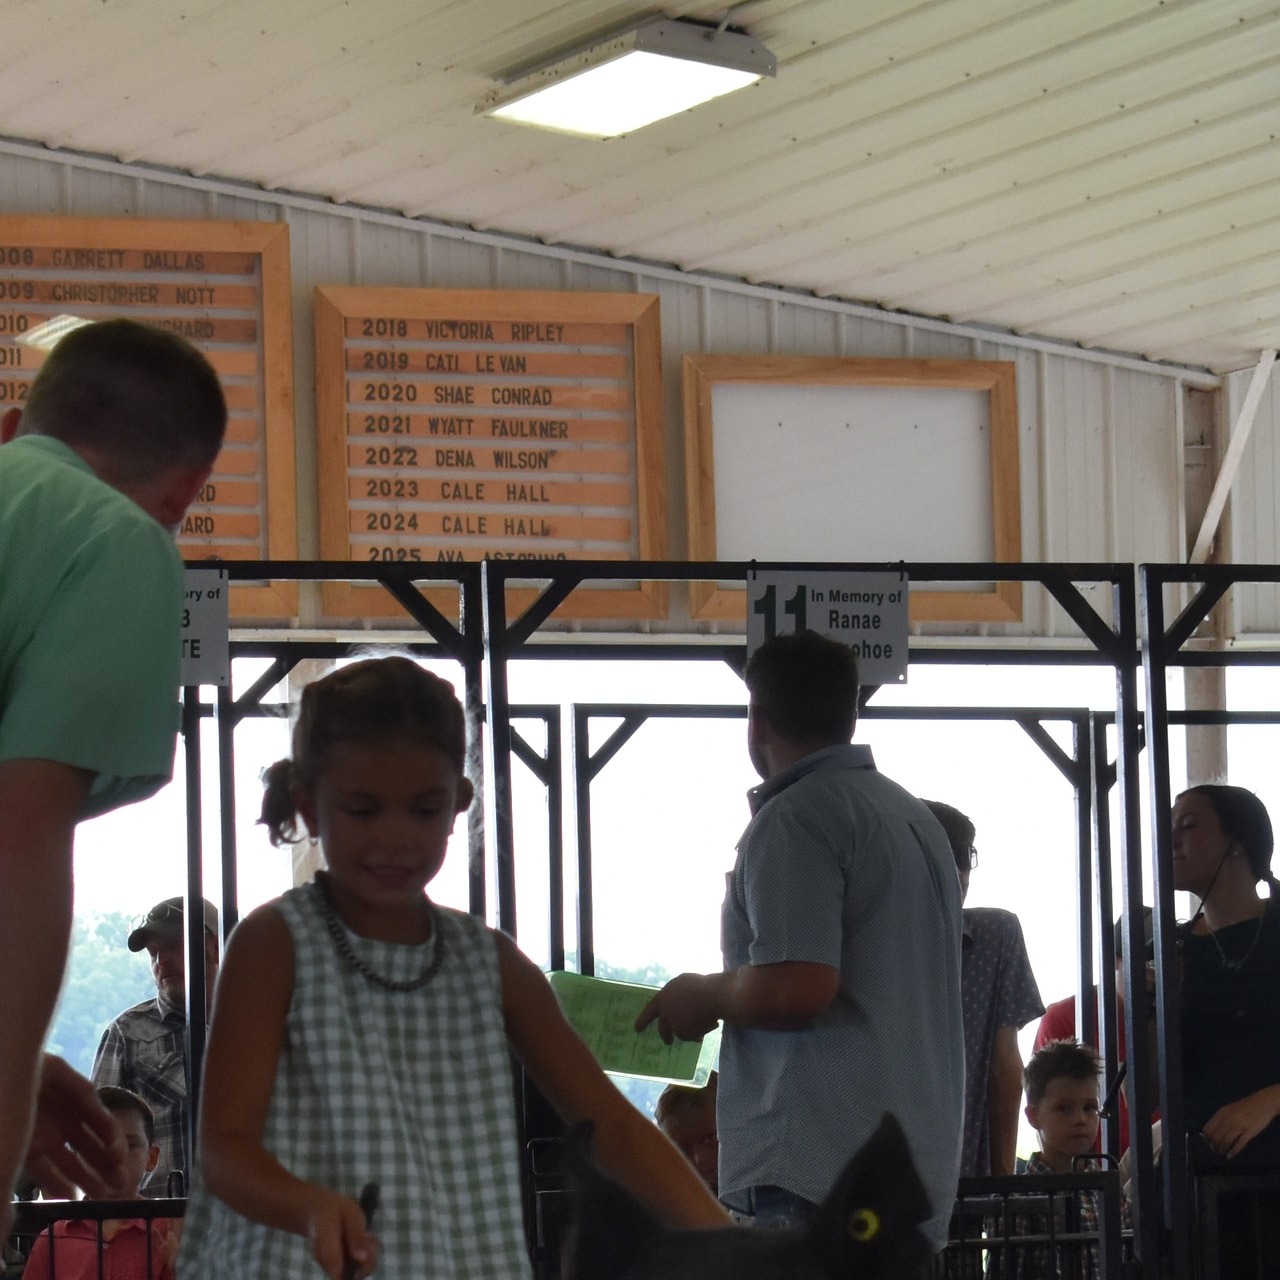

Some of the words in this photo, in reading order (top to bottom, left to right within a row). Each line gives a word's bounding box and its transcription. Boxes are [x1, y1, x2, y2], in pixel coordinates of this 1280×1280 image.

[53, 250, 126, 269] GARRETT
[144, 253, 206, 271] DALLAS
[52, 285, 159, 305] CHRISTOPHER
[176, 288, 216, 306] NOTT
[362, 319, 408, 337] 2018
[426, 322, 494, 341] VICTORIA
[512, 324, 564, 342] RIPLEY
[363, 353, 408, 370] 2019
[426, 354, 459, 371] CATI
[365, 384, 417, 401] 2020
[434, 386, 475, 404] SHAE
[492, 387, 552, 406] CONRAD
[365, 416, 411, 434] 2021
[428, 417, 473, 436] WYATT
[491, 419, 568, 439] FAULKNER
[365, 448, 418, 466] 2022
[435, 450, 475, 467] DENA
[493, 452, 549, 469] WILSON
[367, 480, 419, 497] 2023
[441, 483, 484, 500] CALE
[506, 484, 550, 502] HALL
[367, 513, 419, 530] 2024
[442, 516, 487, 533] CALE
[504, 518, 550, 536] HALL
[369, 546, 421, 562] 2025
[811, 590, 824, 602] In
[829, 590, 884, 606] Memory
[889, 590, 902, 603] of
[754, 585, 806, 637] 11
[829, 610, 881, 629] Ranae
[852, 640, 892, 659] ohoe
